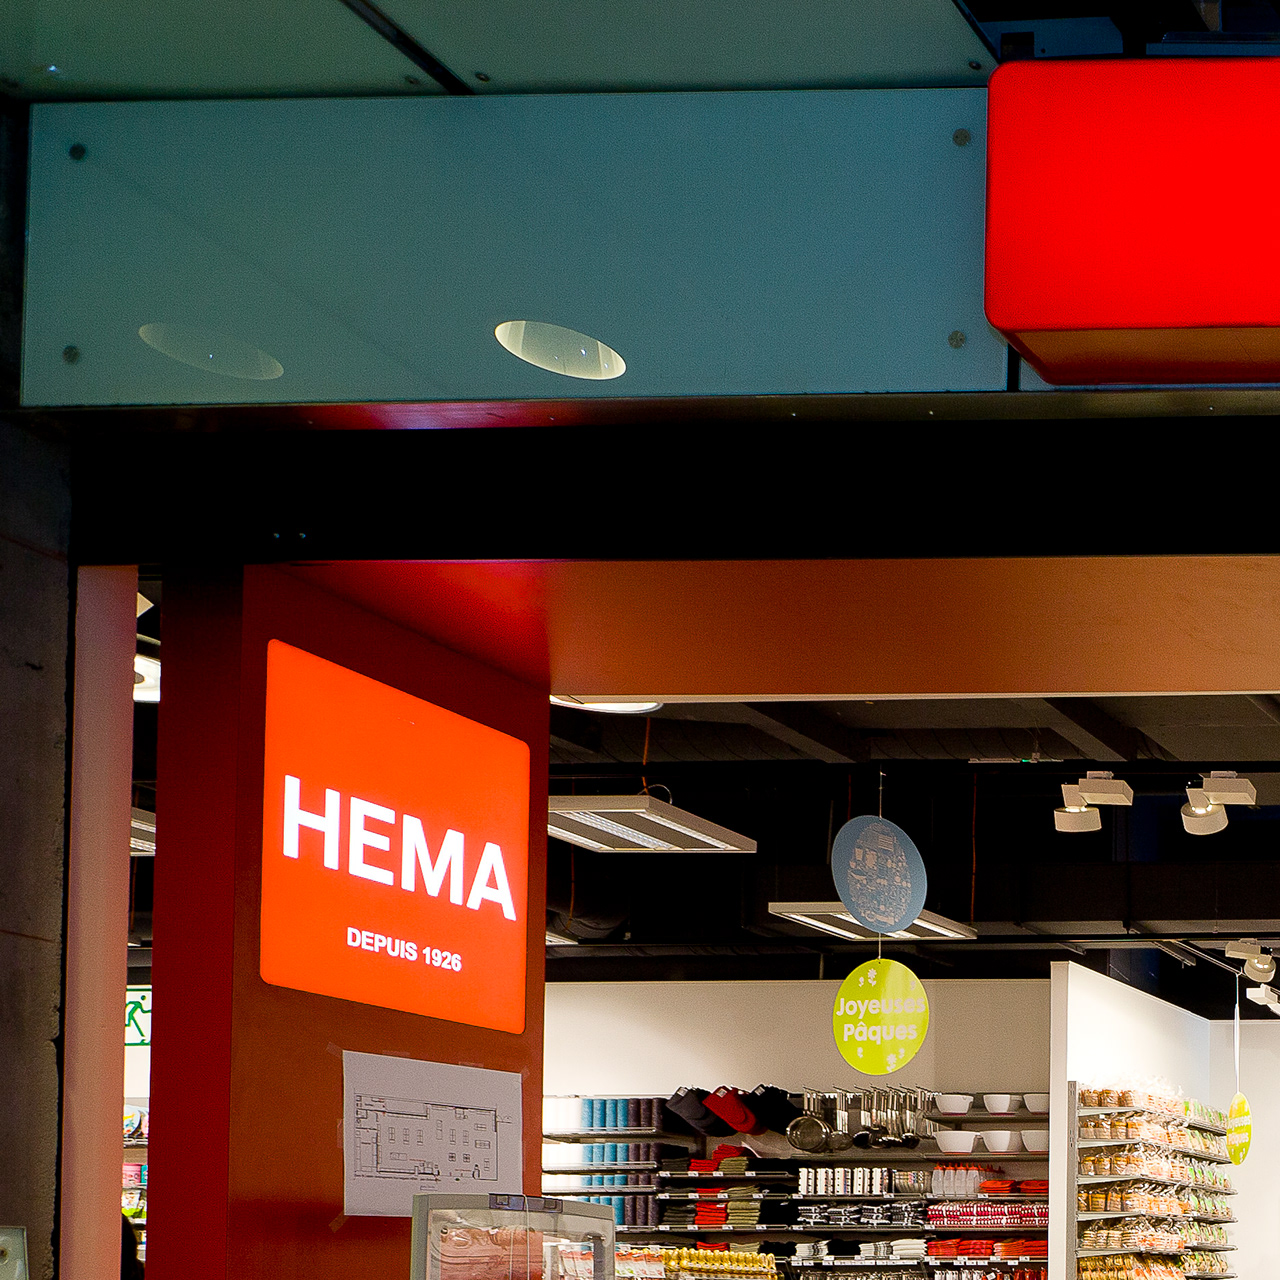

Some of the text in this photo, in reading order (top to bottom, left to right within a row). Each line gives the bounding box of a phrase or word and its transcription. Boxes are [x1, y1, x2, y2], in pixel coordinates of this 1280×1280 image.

[282, 774, 516, 921] HEMA
[347, 926, 462, 972] DEPUIS 1926
[836, 997, 926, 1019] Joyeuses
[843, 1021, 918, 1045] Pâques
